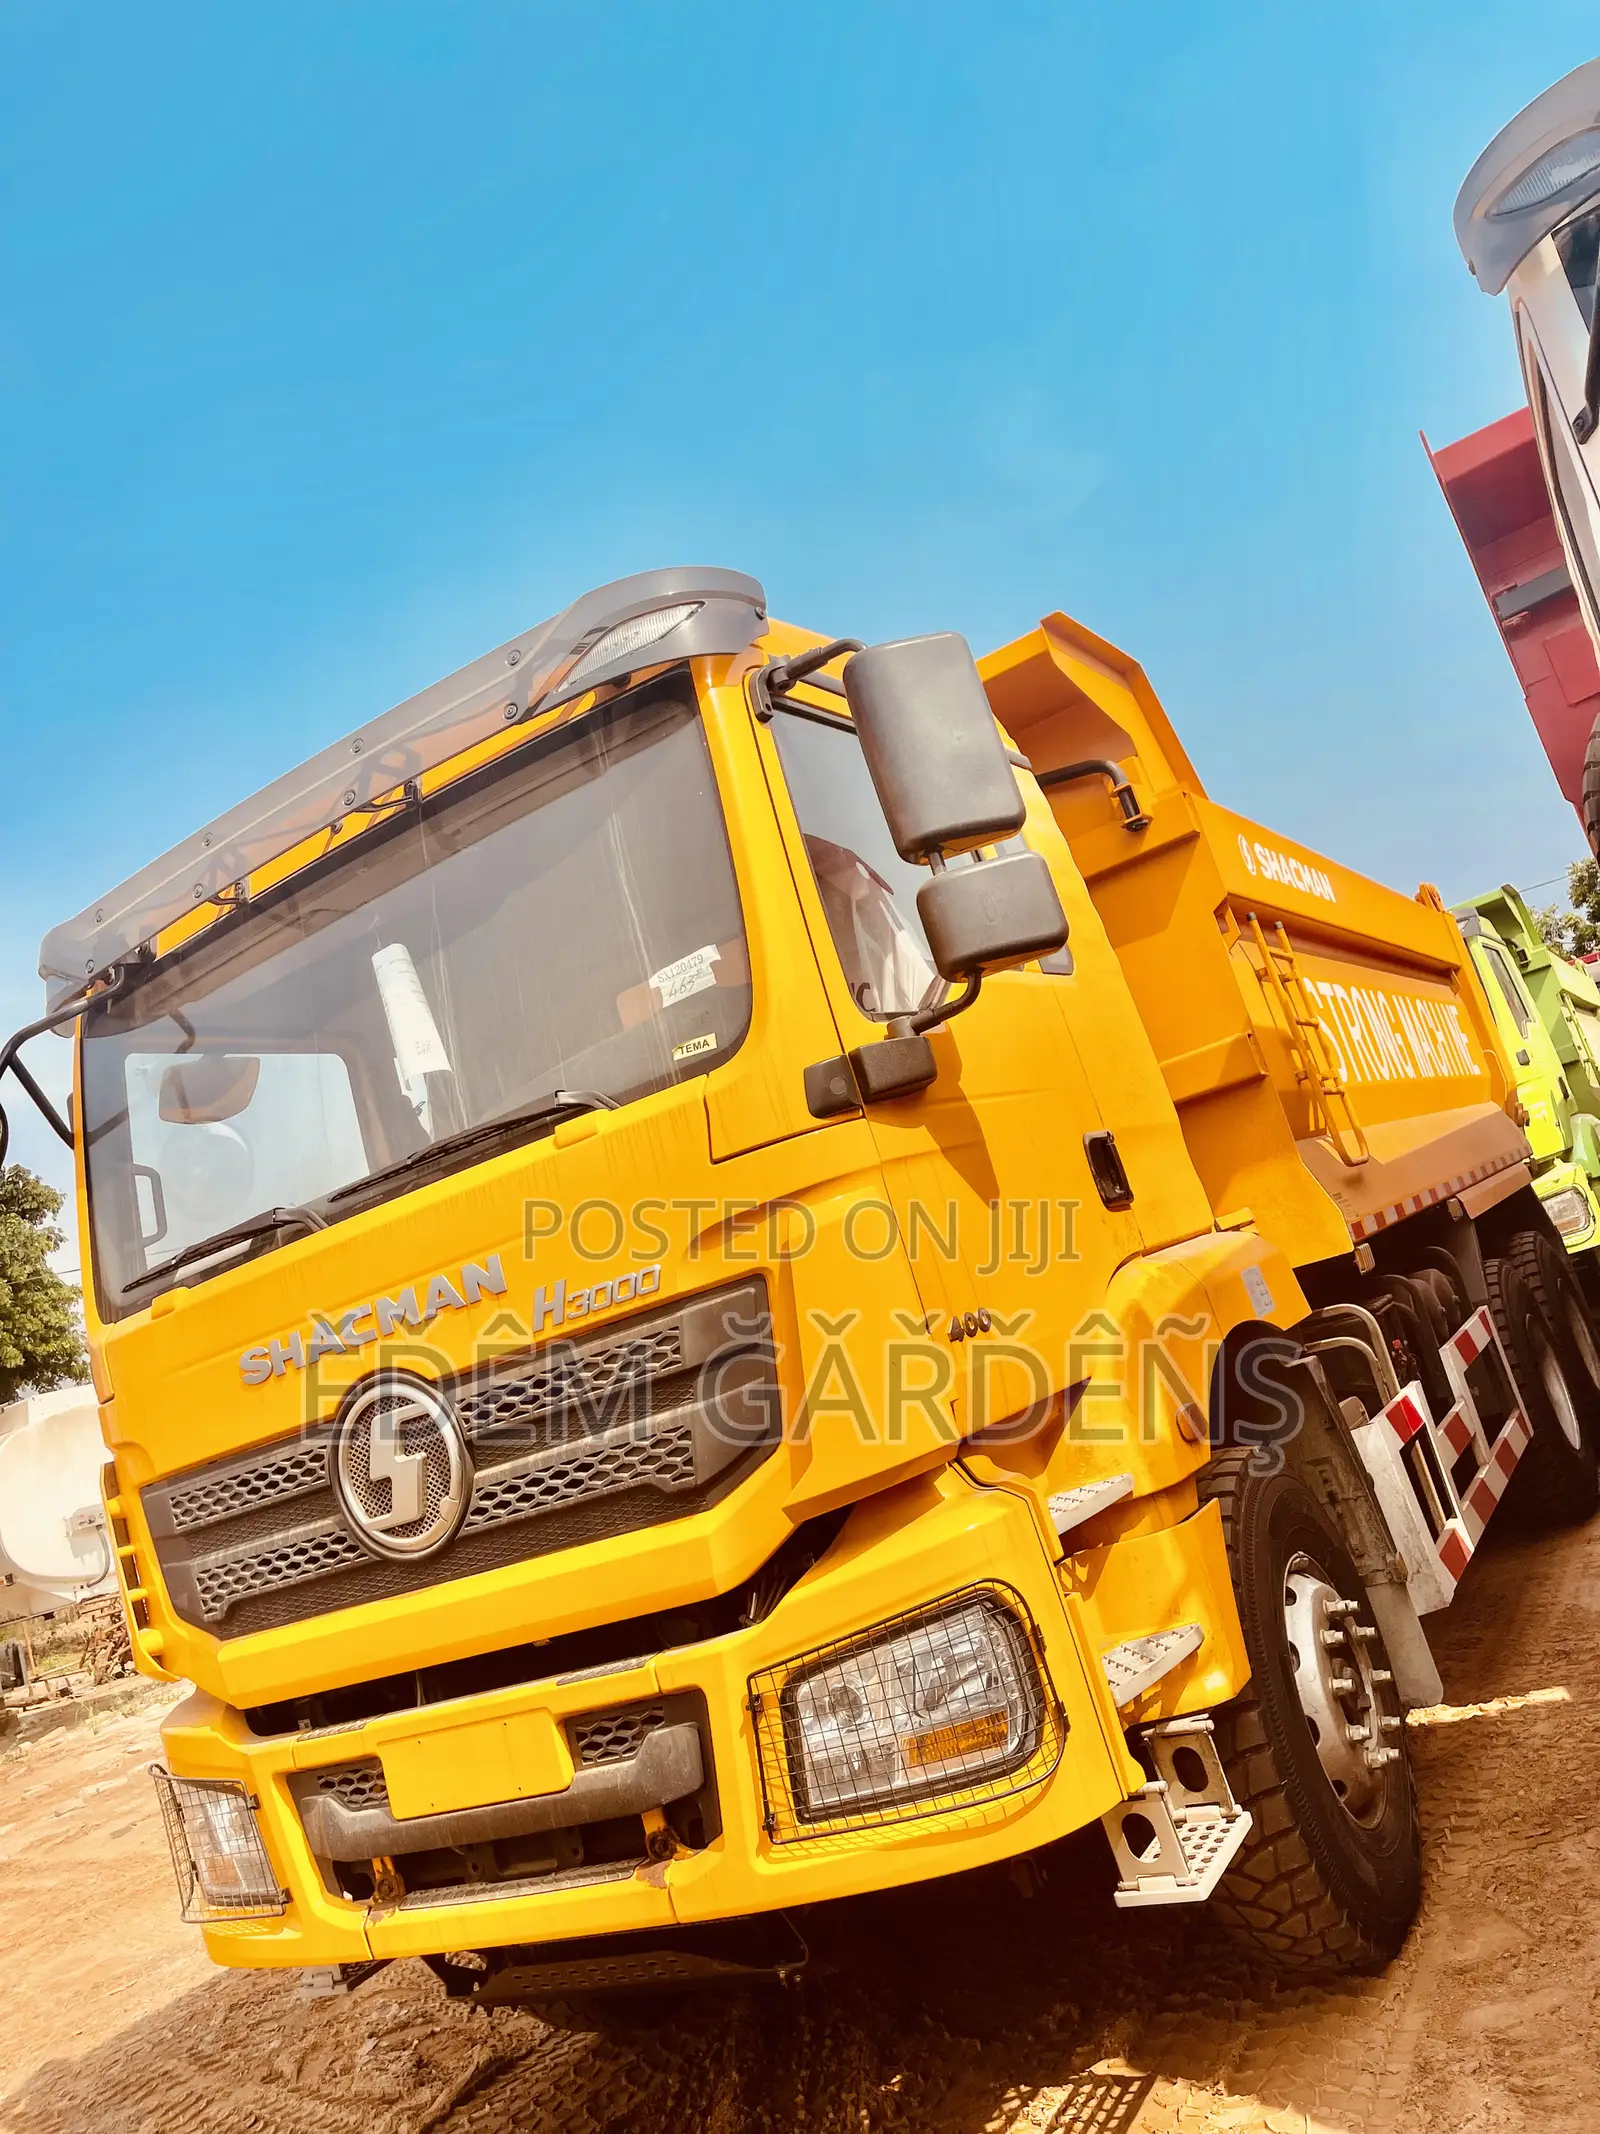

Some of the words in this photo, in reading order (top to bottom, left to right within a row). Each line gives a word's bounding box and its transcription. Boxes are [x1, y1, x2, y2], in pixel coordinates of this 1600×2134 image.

[1253, 842, 1336, 903] SHACMAN
[679, 1038, 710, 1055] TEMA
[1303, 976, 1416, 1083] STRONG
[240, 1253, 507, 1386] SHACMAN
[532, 1263, 662, 1333] H3000
[947, 1306, 992, 1343] 400
